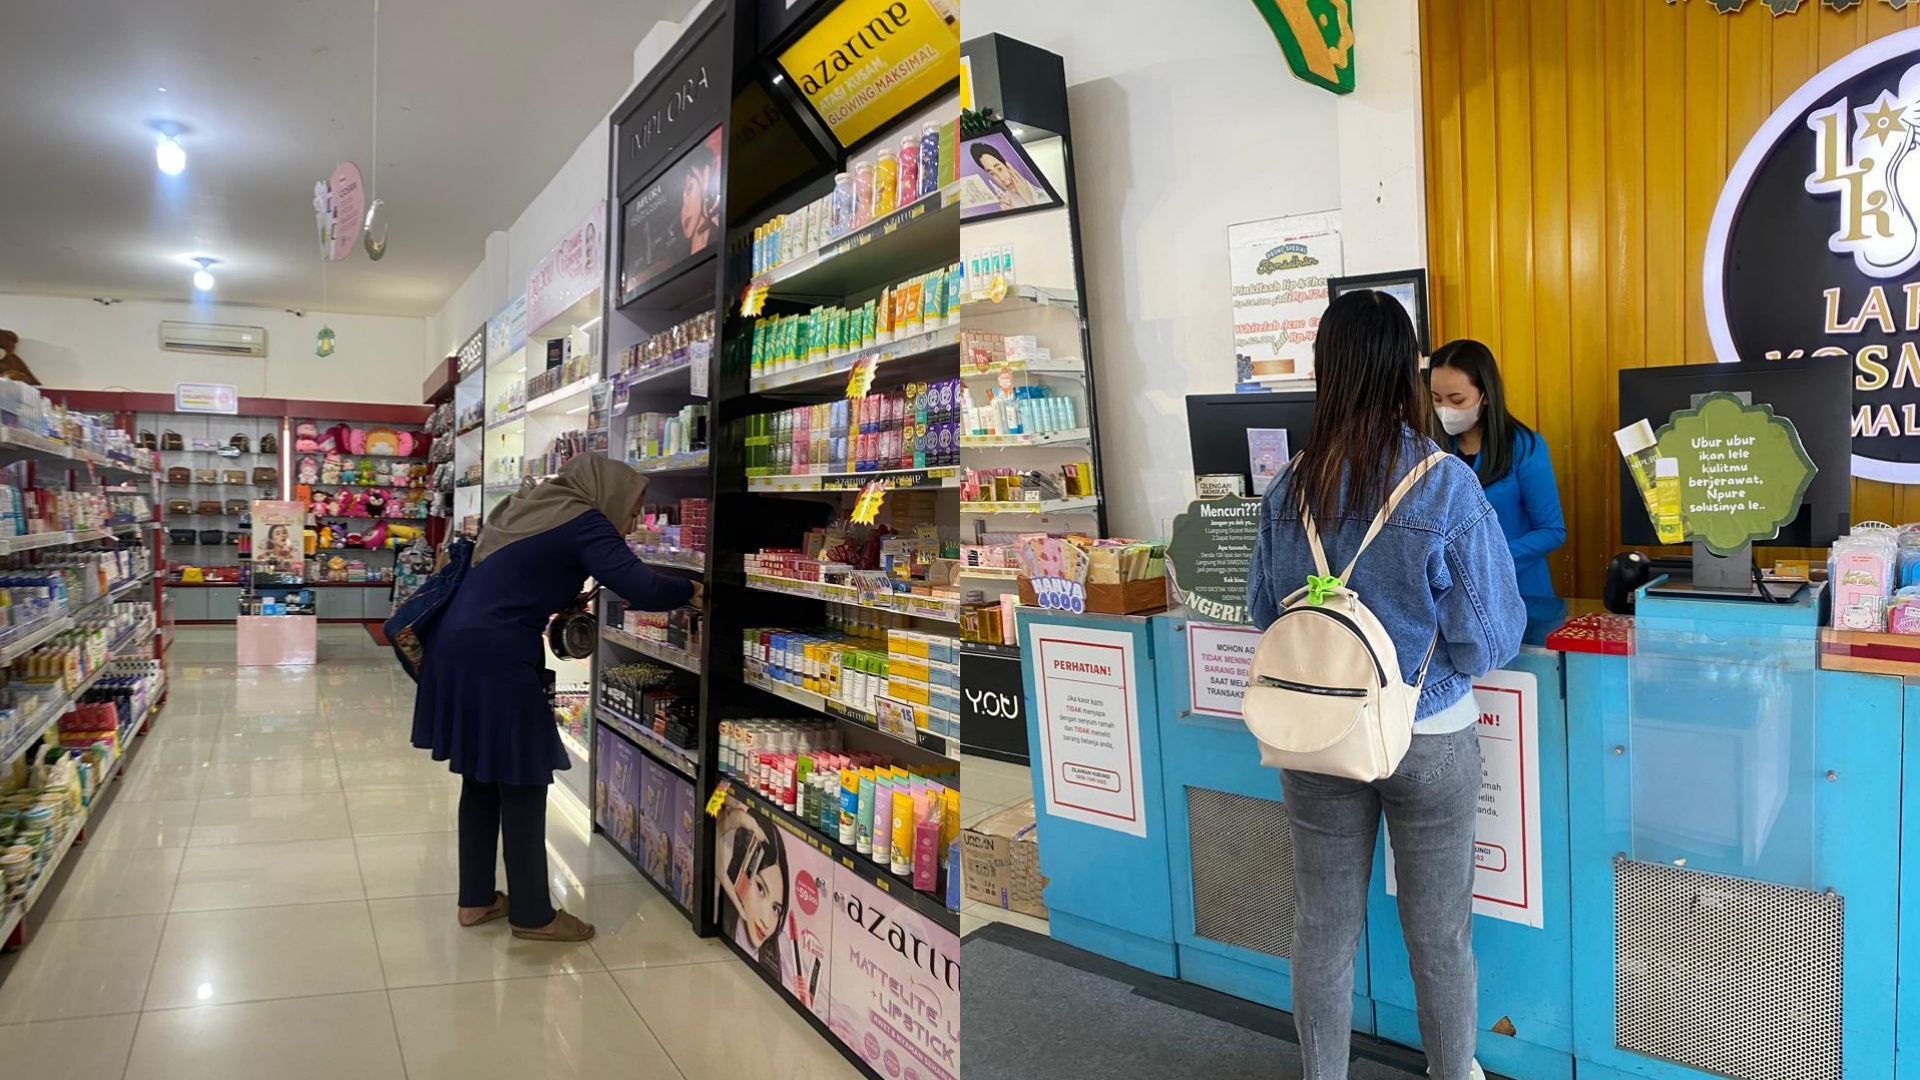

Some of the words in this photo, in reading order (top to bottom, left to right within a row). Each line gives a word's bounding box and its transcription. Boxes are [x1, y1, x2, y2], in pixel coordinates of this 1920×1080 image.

[800, 1, 911, 96] azarine
[828, 86, 875, 126] GLOWING
[875, 45, 937, 93] MAKSIMAL
[1691, 436, 1722, 449] Ubur
[1726, 434, 1756, 447] ubur
[1699, 450, 1725, 461] ikan
[1728, 448, 1750, 459] lele
[1702, 463, 1748, 474] kulitmu
[1688, 475, 1764, 490] berjerawat,
[1706, 488, 1746, 503] Npure
[1689, 502, 1745, 515] solusinya
[1031, 577, 1085, 600] HANYA
[1216, 643, 1243, 653] MOHON
[1244, 646, 1256, 654] AG
[1201, 653, 1223, 662] TIDAK
[1224, 656, 1252, 665] MENING
[1053, 659, 1112, 677] PERHATIAN!
[1204, 664, 1236, 675] BARANG
[1236, 669, 1250, 677] BEL
[1210, 676, 1229, 685] SAAT
[1230, 678, 1250, 687] MELA
[1206, 687, 1246, 699] TRANSAKS
[1090, 697, 1104, 706] kami
[1066, 705, 1082, 713] TIDAK
[1082, 708, 1106, 718] menyapa
[1059, 714, 1078, 723] dengan
[1078, 717, 1097, 726] senyum
[1097, 720, 1115, 728] ramah
[1064, 724, 1074, 732] dan
[1074, 725, 1090, 734] TIDAK
[1063, 734, 1081, 744] barang
[1081, 737, 1100, 746] belanja
[846, 892, 960, 992] azarin
[849, 944, 938, 1029] MATTELITE
[879, 991, 955, 1069] LIPSTICK
